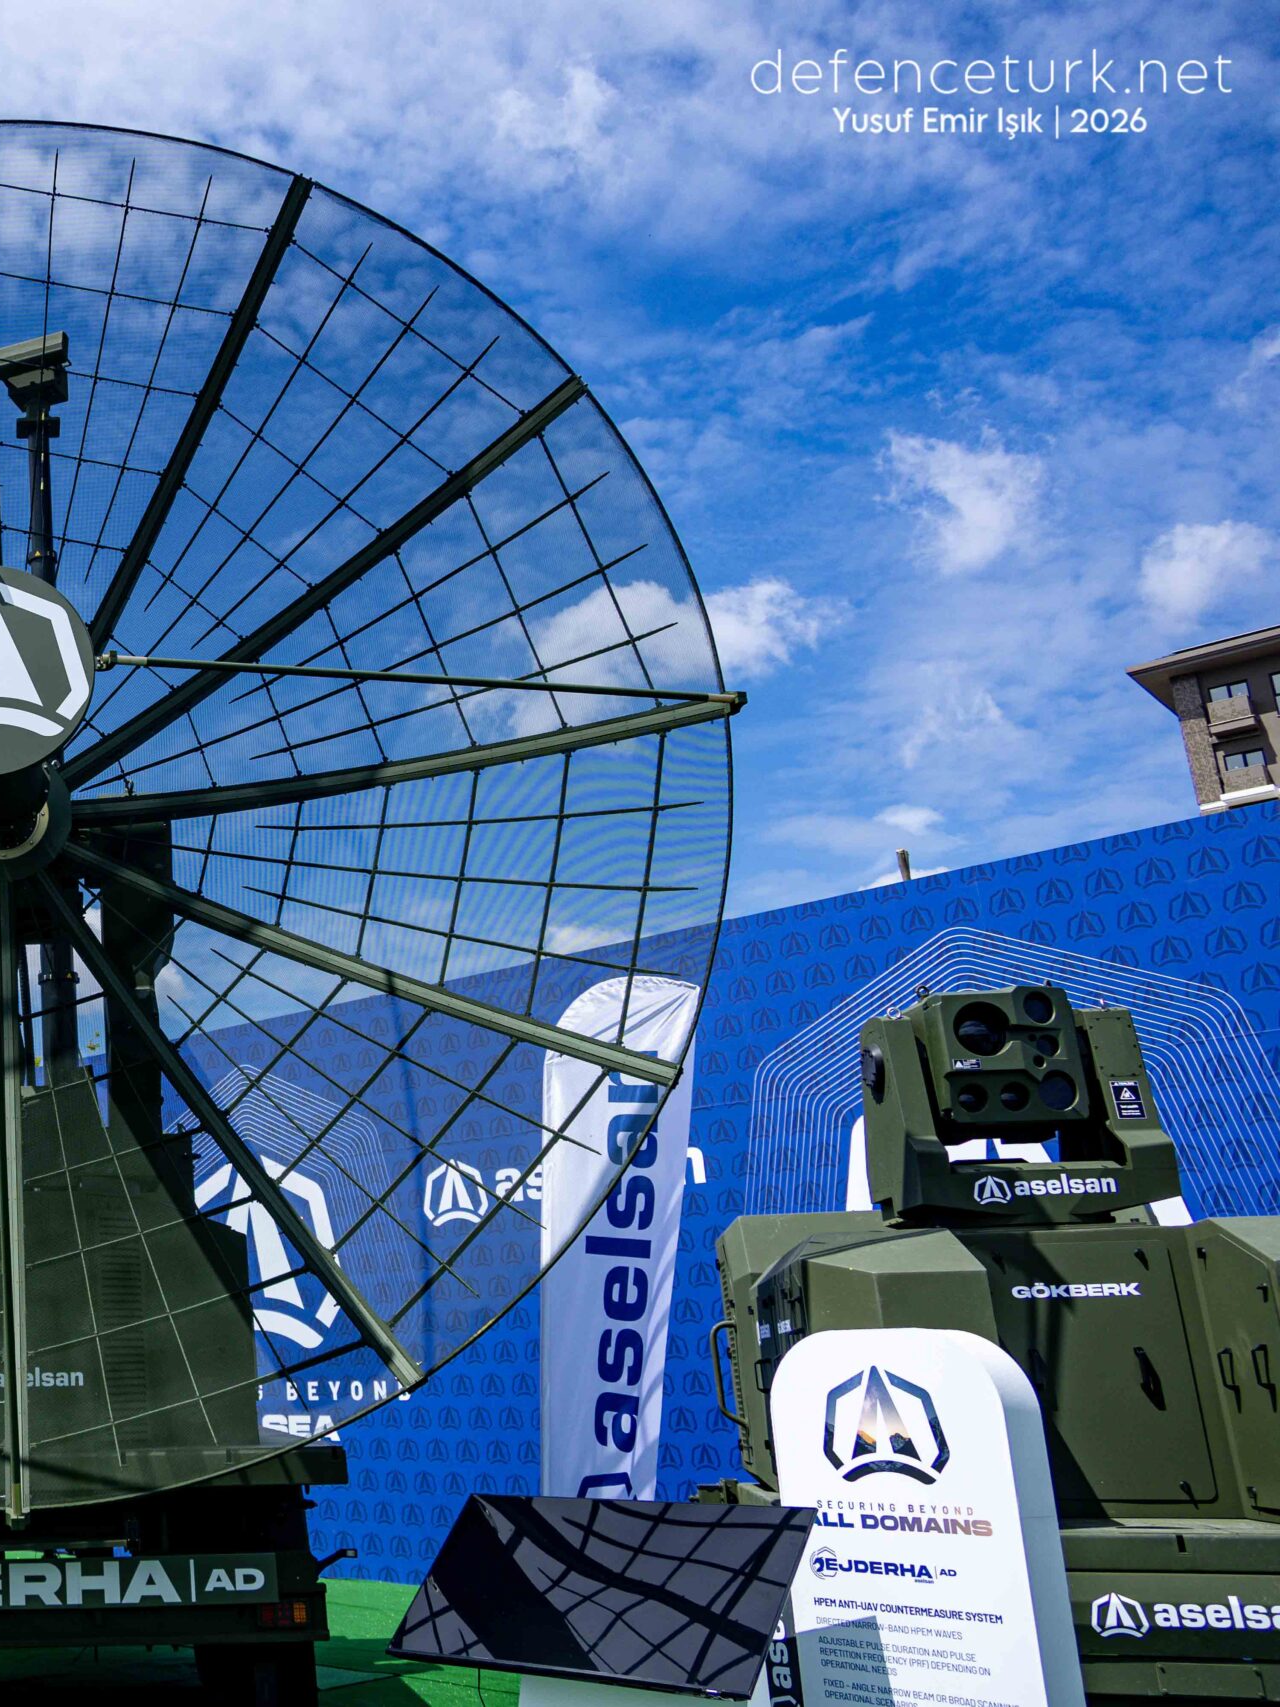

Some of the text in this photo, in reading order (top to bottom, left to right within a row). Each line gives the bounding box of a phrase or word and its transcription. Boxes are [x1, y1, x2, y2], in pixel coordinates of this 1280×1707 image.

[1014, 1173, 1117, 1196] aselsan
[1011, 1282, 1141, 1299] GÖKBERK
[817, 1500, 973, 1516] SECURING BEYOND
[860, 1514, 993, 1537] DOMAINS
[205, 1567, 266, 1592] AD
[825, 1557, 957, 1579] EJDERHA AD
[813, 1597, 1003, 1624] HPEM ANTI-UAV COUNTERMEASURE SYSTEM
[815, 1616, 963, 1640] DIRECTED NARROW-BAND HPEM WAVES
[818, 1635, 976, 1662] ADJUSTABLE PULSE DURATION AND PULSE
[820, 1647, 991, 1676] REPETITION FREQUENCY (PRF) DEPENDING ON
[821, 1659, 898, 1676] OPERATIONAL NEEDS
[823, 1678, 845, 1689] FIXED
[851, 1682, 876, 1693] ANGLE
[877, 1686, 911, 1698] NARROW
[913, 1691, 935, 1701] BEAM
[936, 1694, 947, 1703] OR
[948, 1695, 976, 1707] BROAD
[824, 1690, 874, 1705] OPERATIONAL
